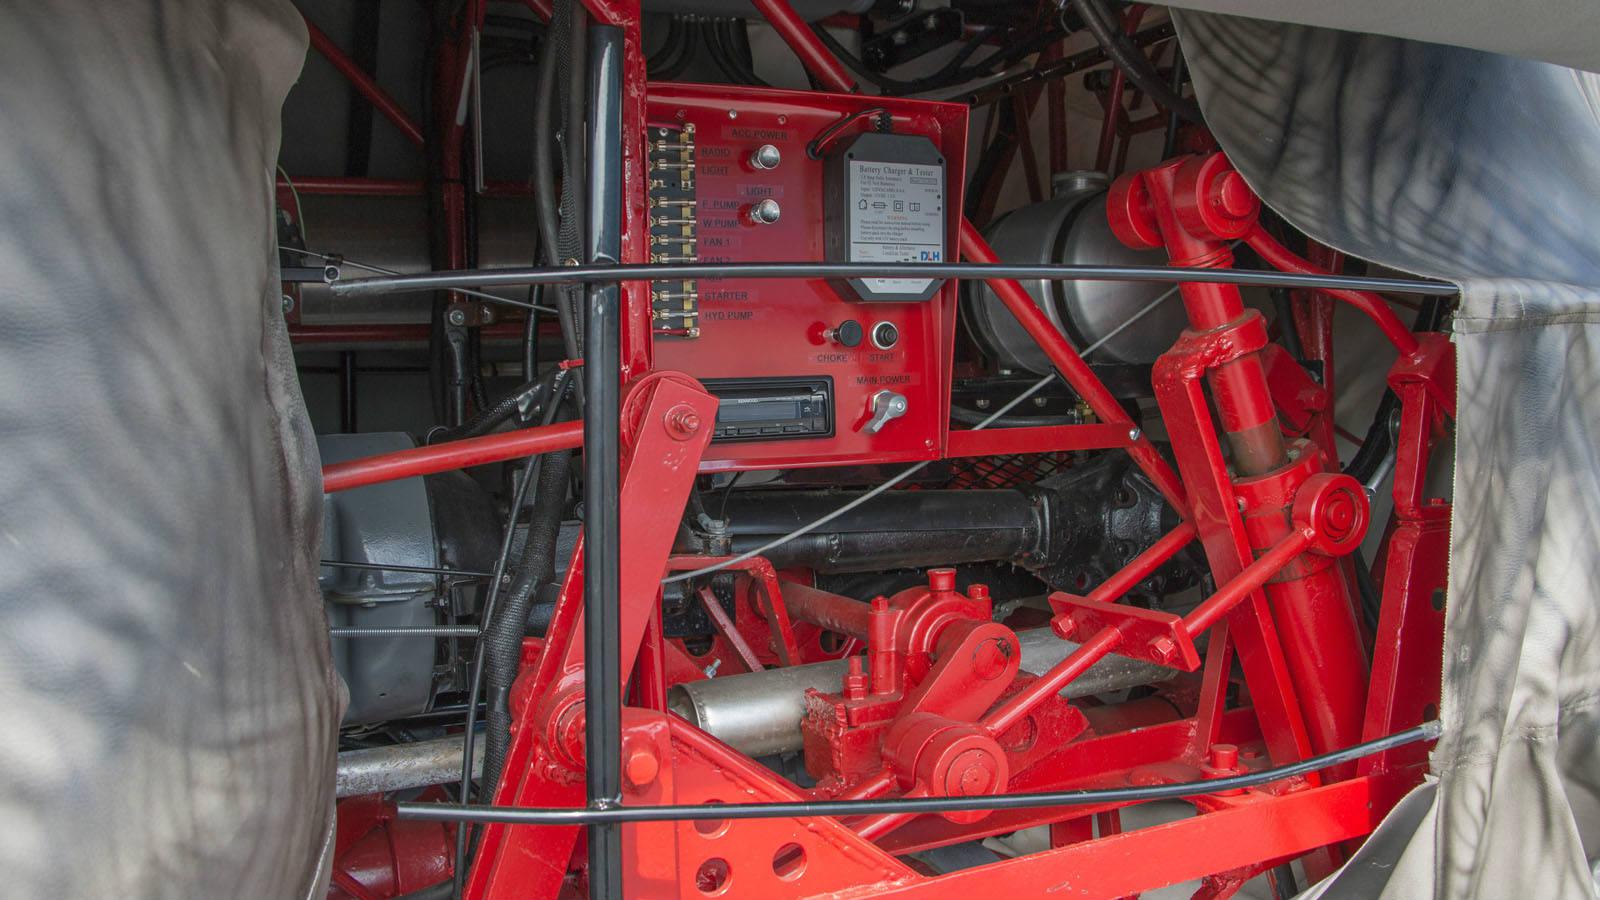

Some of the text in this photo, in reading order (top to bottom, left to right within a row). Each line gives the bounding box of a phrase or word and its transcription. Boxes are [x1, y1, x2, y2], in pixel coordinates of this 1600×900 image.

[754, 129, 788, 140] POWER
[702, 147, 729, 157] RADIO
[702, 166, 729, 176] LIGHT
[859, 165, 881, 174] Battery
[883, 167, 907, 176] Charger
[916, 168, 934, 176] Tester
[745, 186, 774, 196] LIGHT
[713, 200, 739, 210] PUMP
[703, 237, 723, 247] FAN
[920, 251, 940, 261] DLH
[704, 291, 748, 301] STARTER
[727, 311, 753, 321] PUMP
[817, 353, 848, 363] CHOKE
[869, 352, 894, 362] START
[856, 374, 911, 385] MAIN POWER
